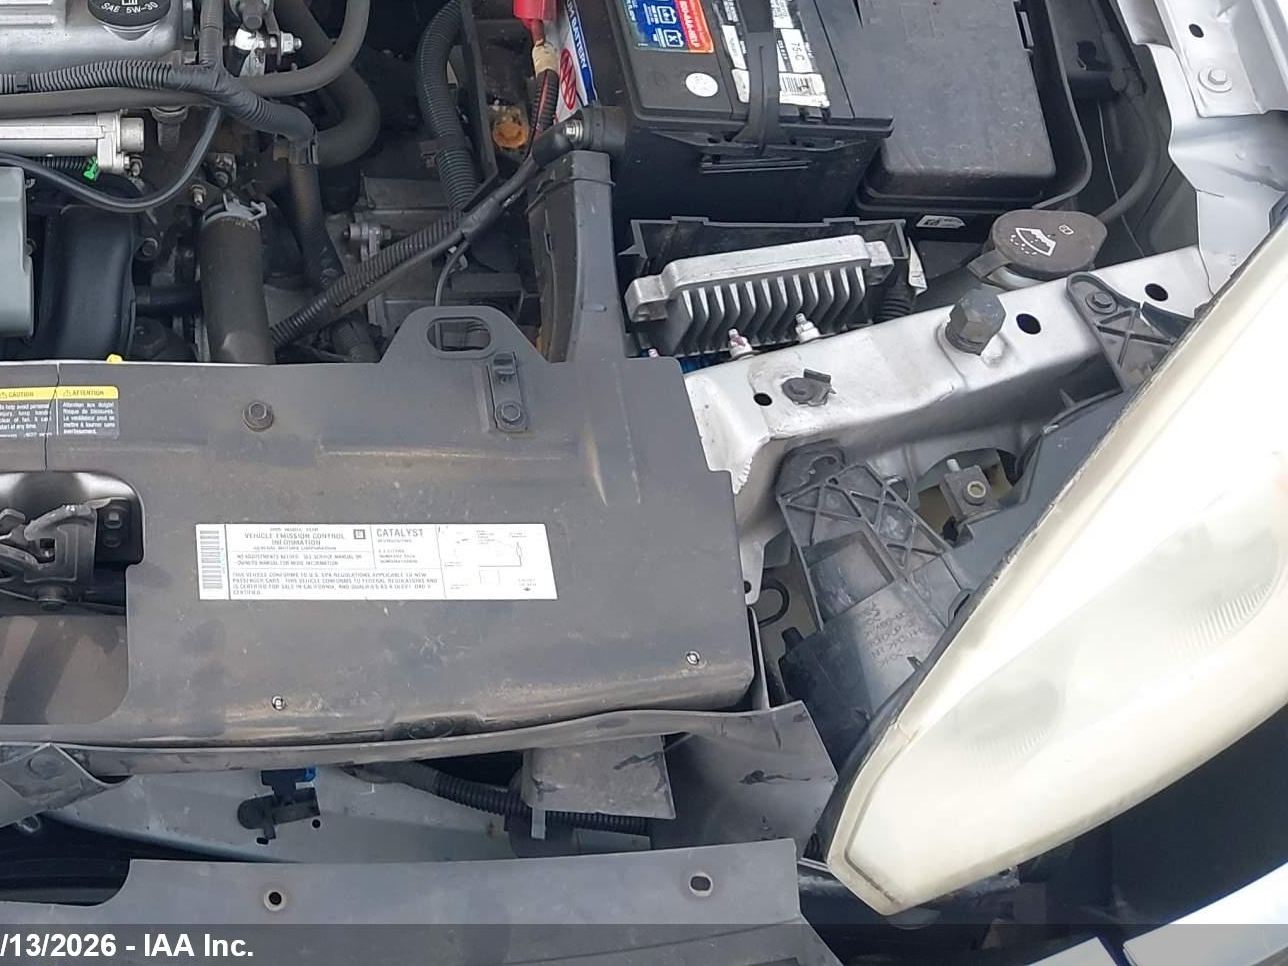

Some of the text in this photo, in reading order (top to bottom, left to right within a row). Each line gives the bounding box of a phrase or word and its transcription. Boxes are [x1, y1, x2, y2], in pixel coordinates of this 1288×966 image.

[100, 2, 121, 13] SAE
[571, 16, 588, 68] BATTERY
[376, 528, 423, 537] CATALYST
